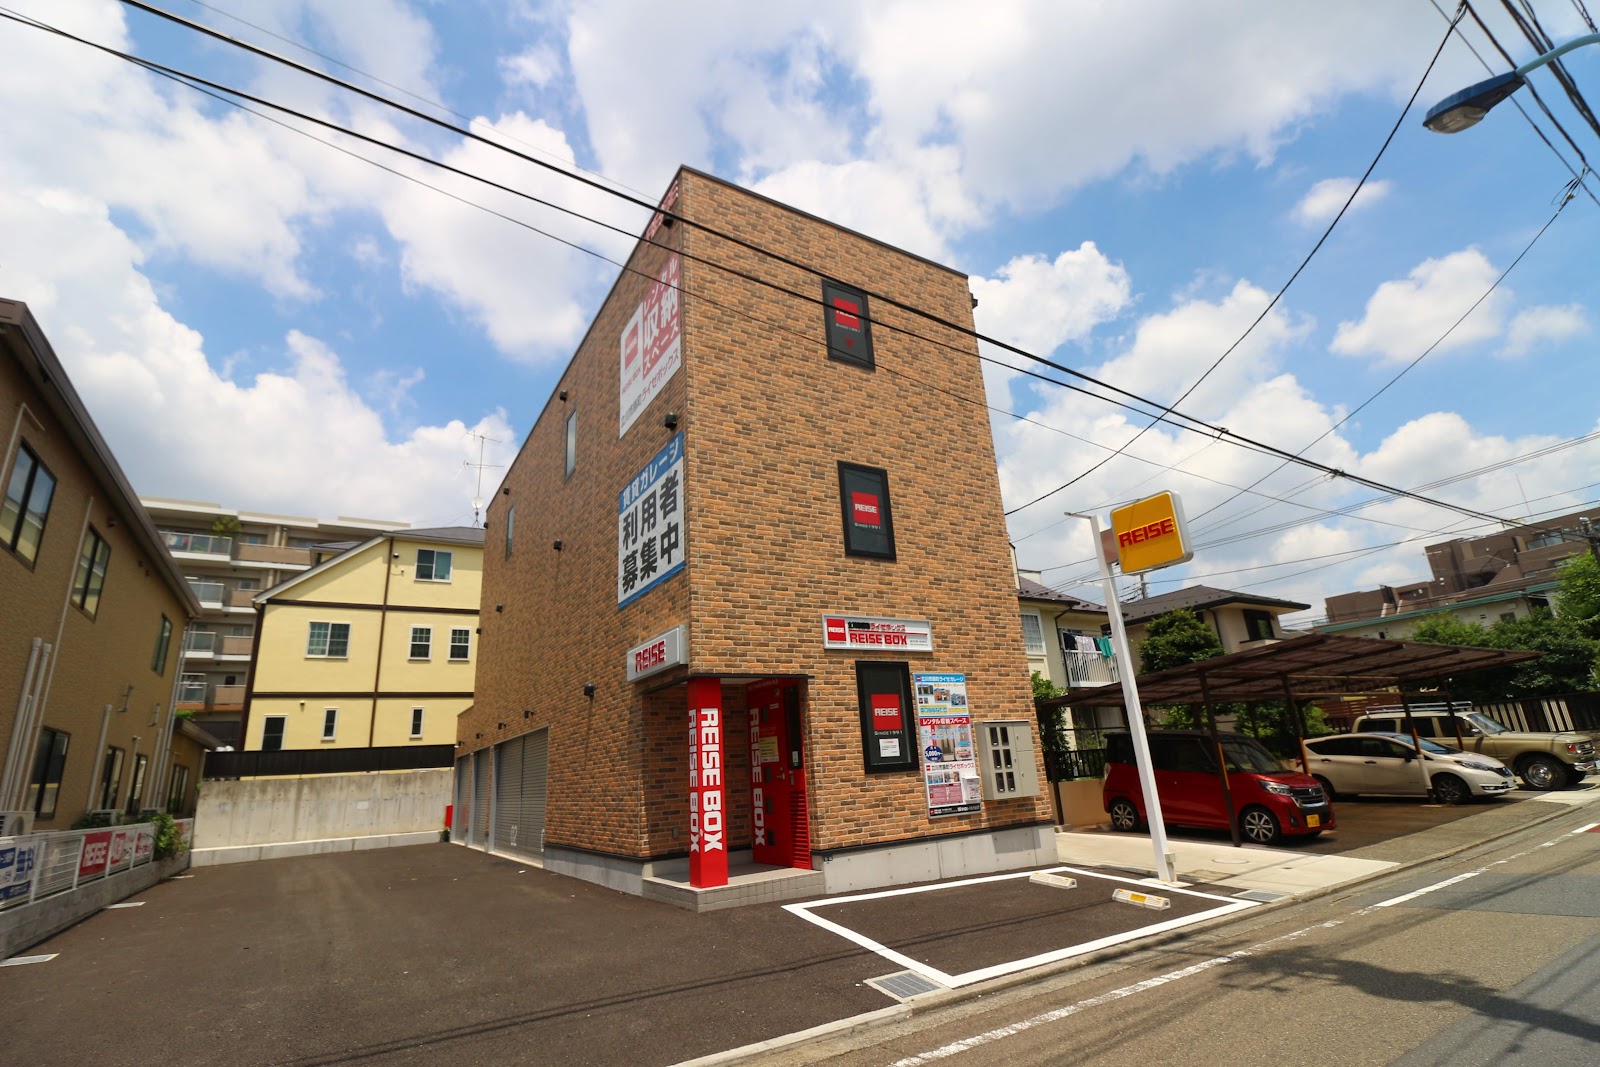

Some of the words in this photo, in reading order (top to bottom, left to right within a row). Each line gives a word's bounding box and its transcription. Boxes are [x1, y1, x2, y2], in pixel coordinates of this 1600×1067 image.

[643, 258, 678, 316] レンタル
[644, 279, 678, 350] 収納
[643, 317, 679, 375] スペース
[622, 437, 679, 510] 賃貸ガレージ
[622, 469, 679, 551] 利用者
[854, 503, 878, 514] REISE
[1118, 518, 1175, 548] REISE
[622, 521, 679, 594] 募集中
[635, 640, 666, 673] REISE
[849, 633, 883, 644] REISE
[884, 634, 908, 645] BOX
[874, 707, 899, 717] REISE
[688, 709, 698, 788] REISE
[701, 708, 721, 787] REISE
[750, 708, 762, 783] REISE
[690, 792, 700, 853] BOX
[703, 790, 723, 852] BOX
[753, 788, 766, 846] BOX
